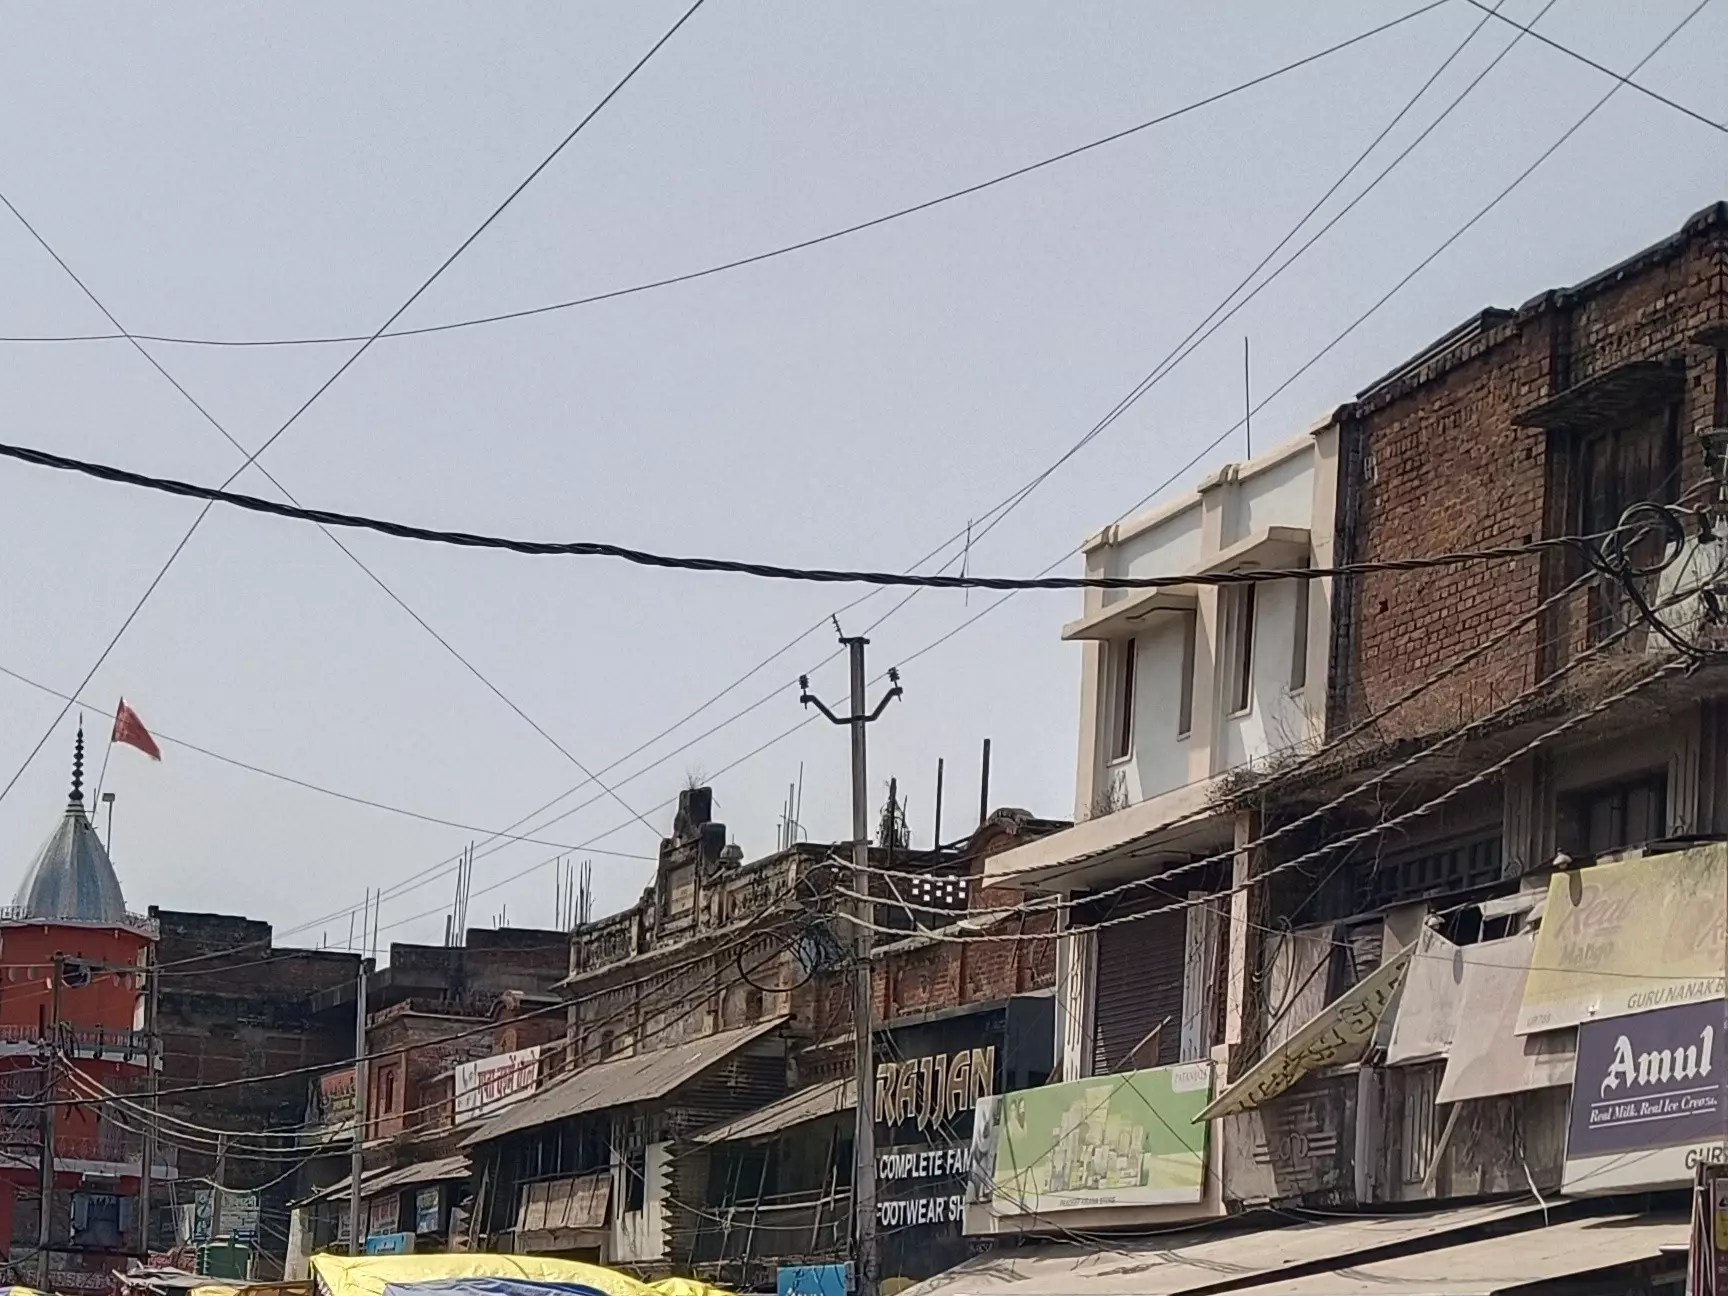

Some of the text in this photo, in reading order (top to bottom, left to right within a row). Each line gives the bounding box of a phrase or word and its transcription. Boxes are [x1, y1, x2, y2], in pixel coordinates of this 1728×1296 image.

[1627, 988, 1664, 1010] GURU
[1665, 979, 1715, 1004] NANAK
[1601, 1025, 1714, 1099] Amul
[875, 1045, 996, 1132] RAJJAN
[1590, 1106, 1611, 1124] Real
[1640, 1099, 1663, 1116] Real
[1664, 1097, 1680, 1113] Ice
[879, 1150, 943, 1180] COMPLETE
